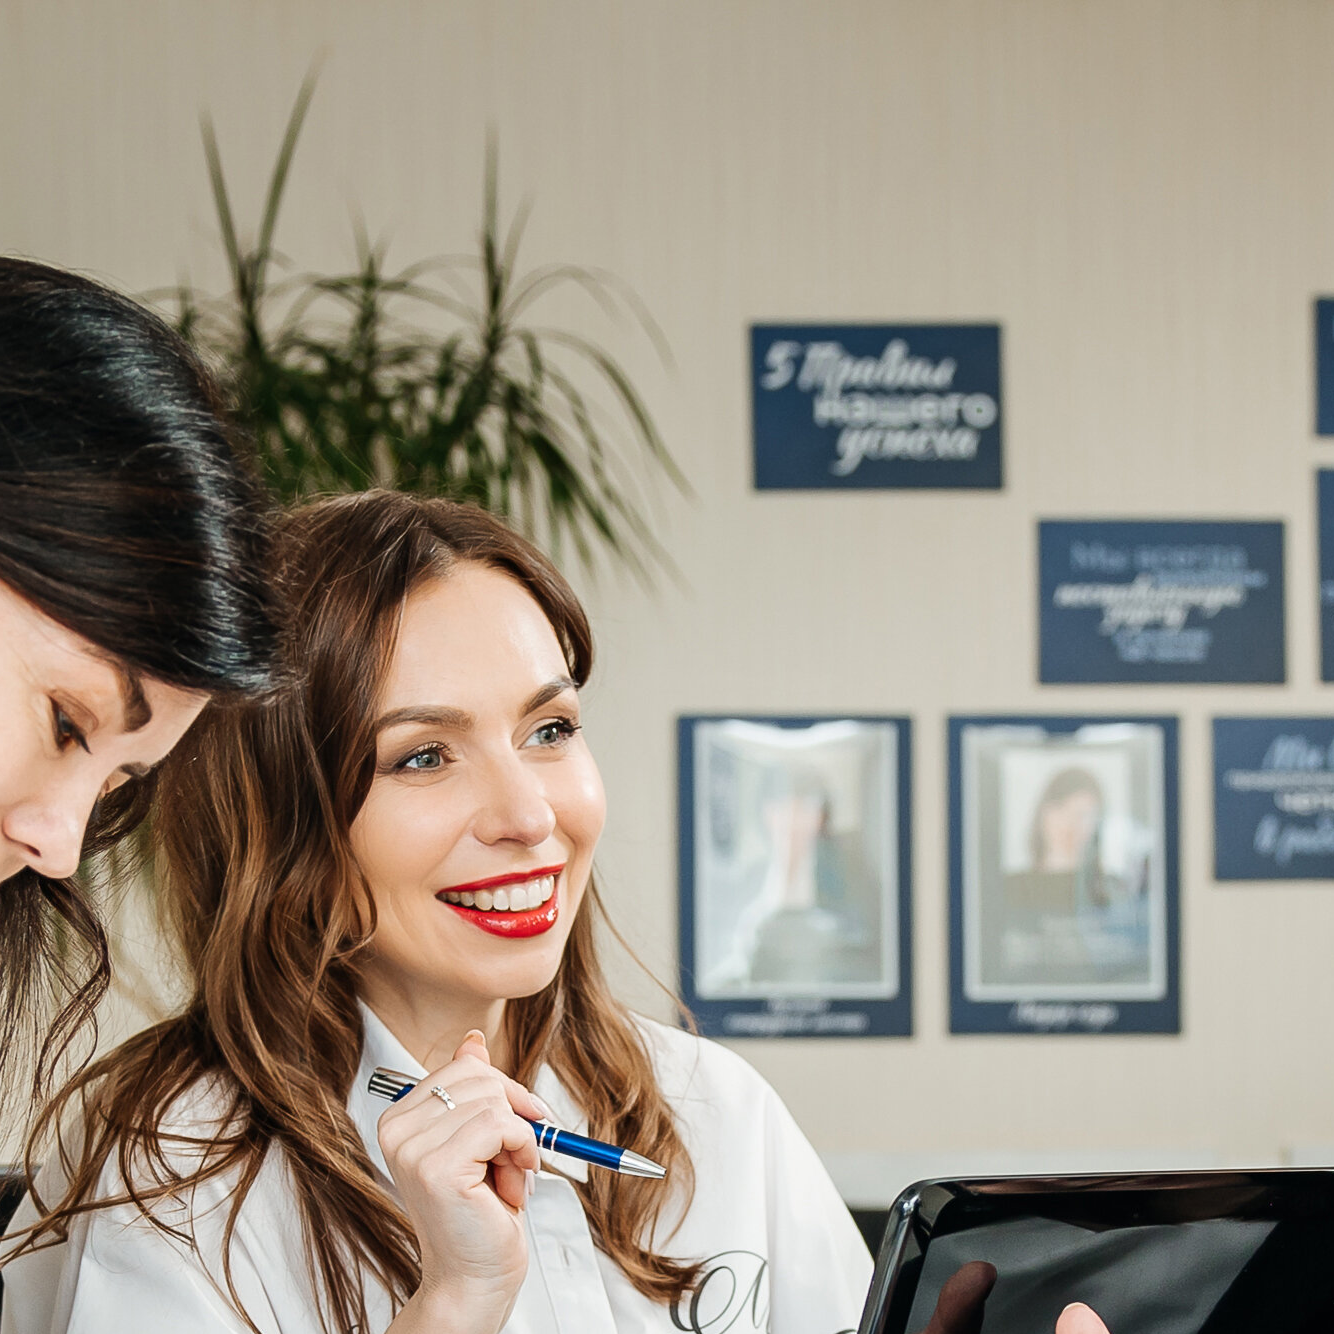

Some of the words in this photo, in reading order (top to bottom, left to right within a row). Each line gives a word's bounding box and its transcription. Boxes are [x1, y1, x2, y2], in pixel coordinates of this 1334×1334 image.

[762, 339, 803, 391] 5
[797, 338, 958, 402] Правил
[814, 392, 998, 429] нашего
